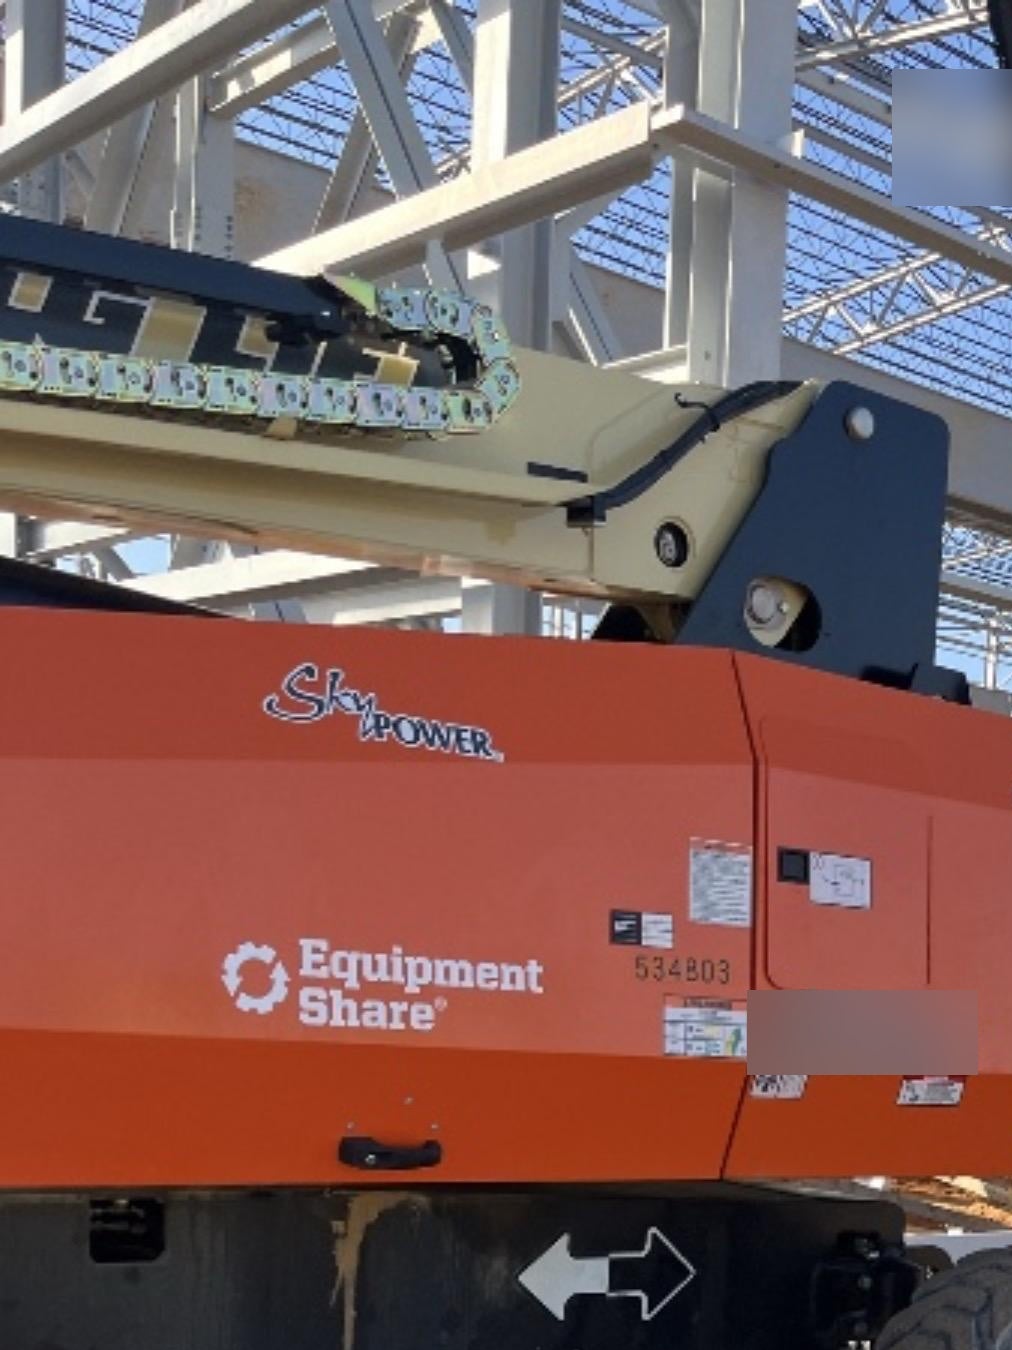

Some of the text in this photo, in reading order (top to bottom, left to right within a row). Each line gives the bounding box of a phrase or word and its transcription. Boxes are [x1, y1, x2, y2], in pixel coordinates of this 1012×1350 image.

[263, 663, 378, 742] Sky
[368, 712, 499, 760] POWER
[299, 938, 544, 994] Equipment
[635, 955, 731, 985] 534803
